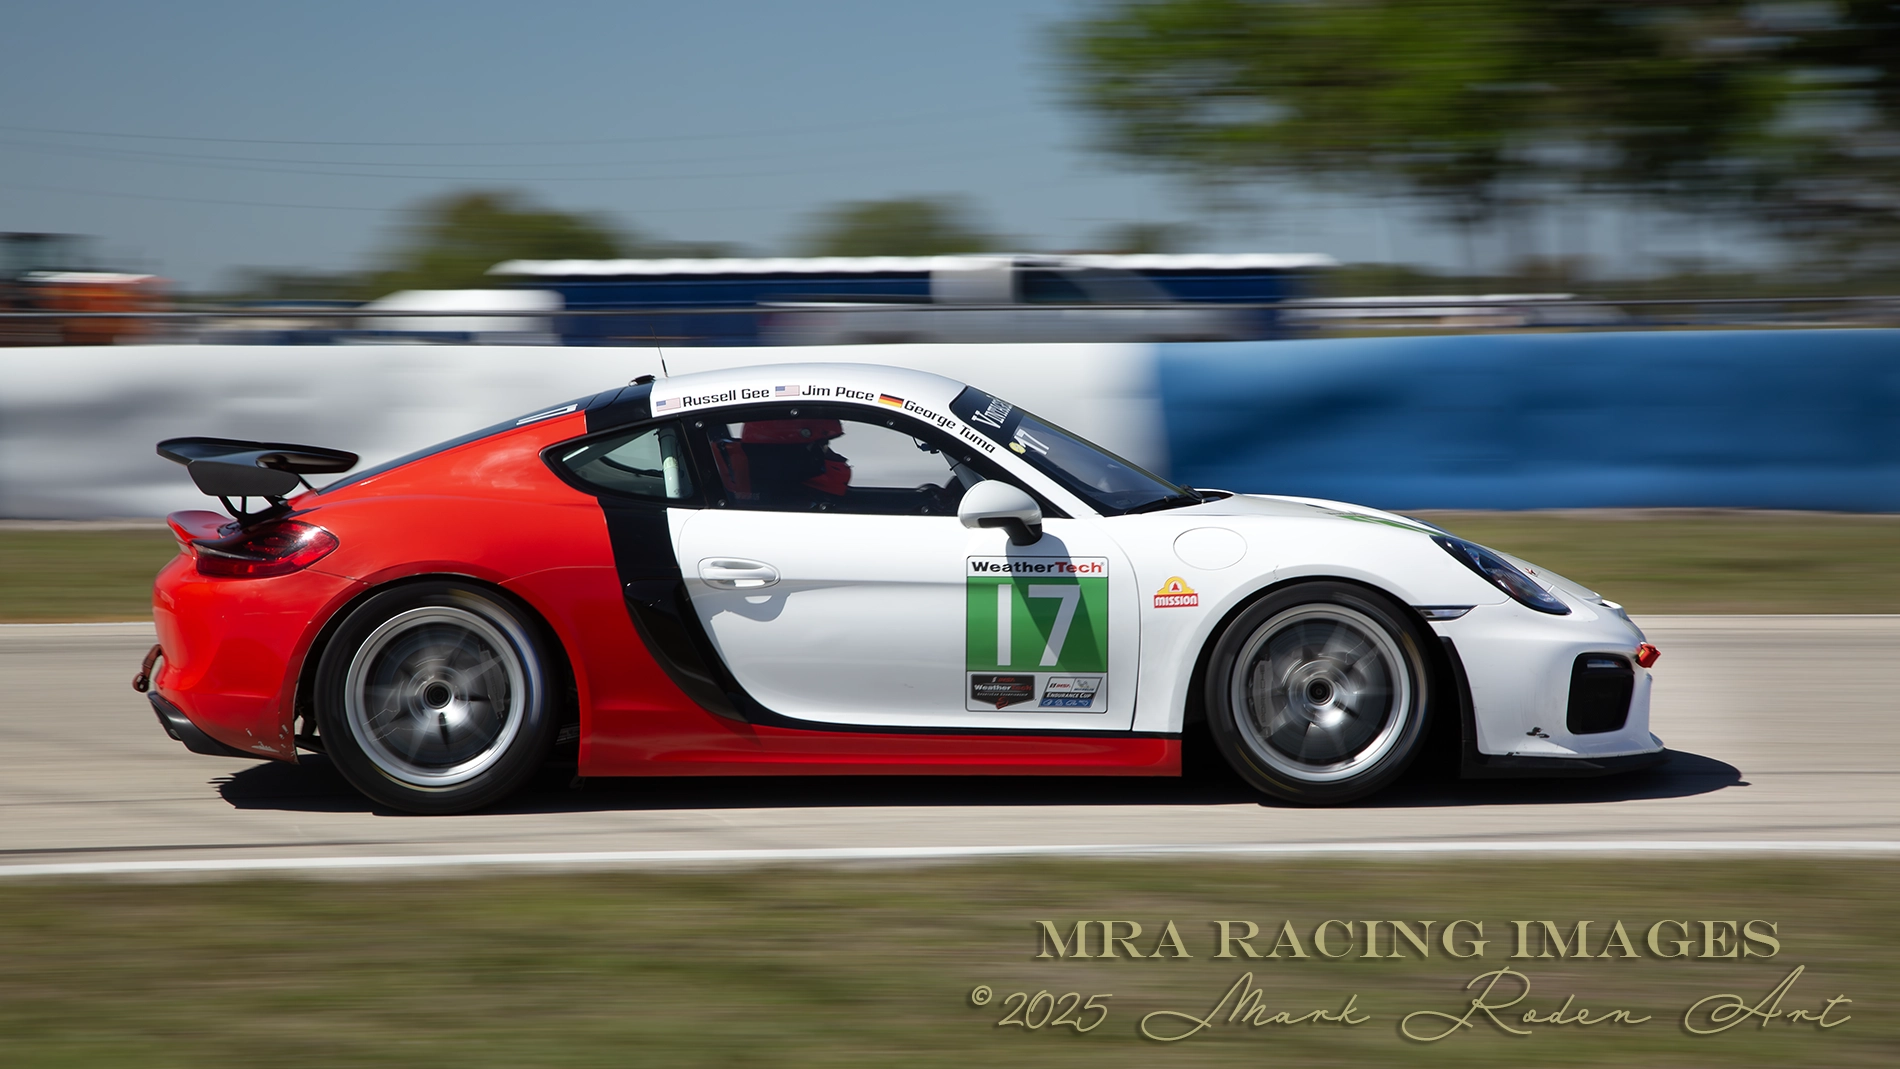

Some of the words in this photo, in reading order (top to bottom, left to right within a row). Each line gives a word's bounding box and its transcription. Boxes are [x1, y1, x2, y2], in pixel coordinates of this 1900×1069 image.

[682, 389, 736, 407] Russell
[741, 388, 770, 400] Gee
[802, 385, 830, 396] Jim
[835, 386, 874, 401] Pace
[904, 399, 957, 429] George
[959, 424, 996, 454] Tuma
[971, 561, 1103, 573] WeatherTech
[997, 584, 1081, 667] 17
